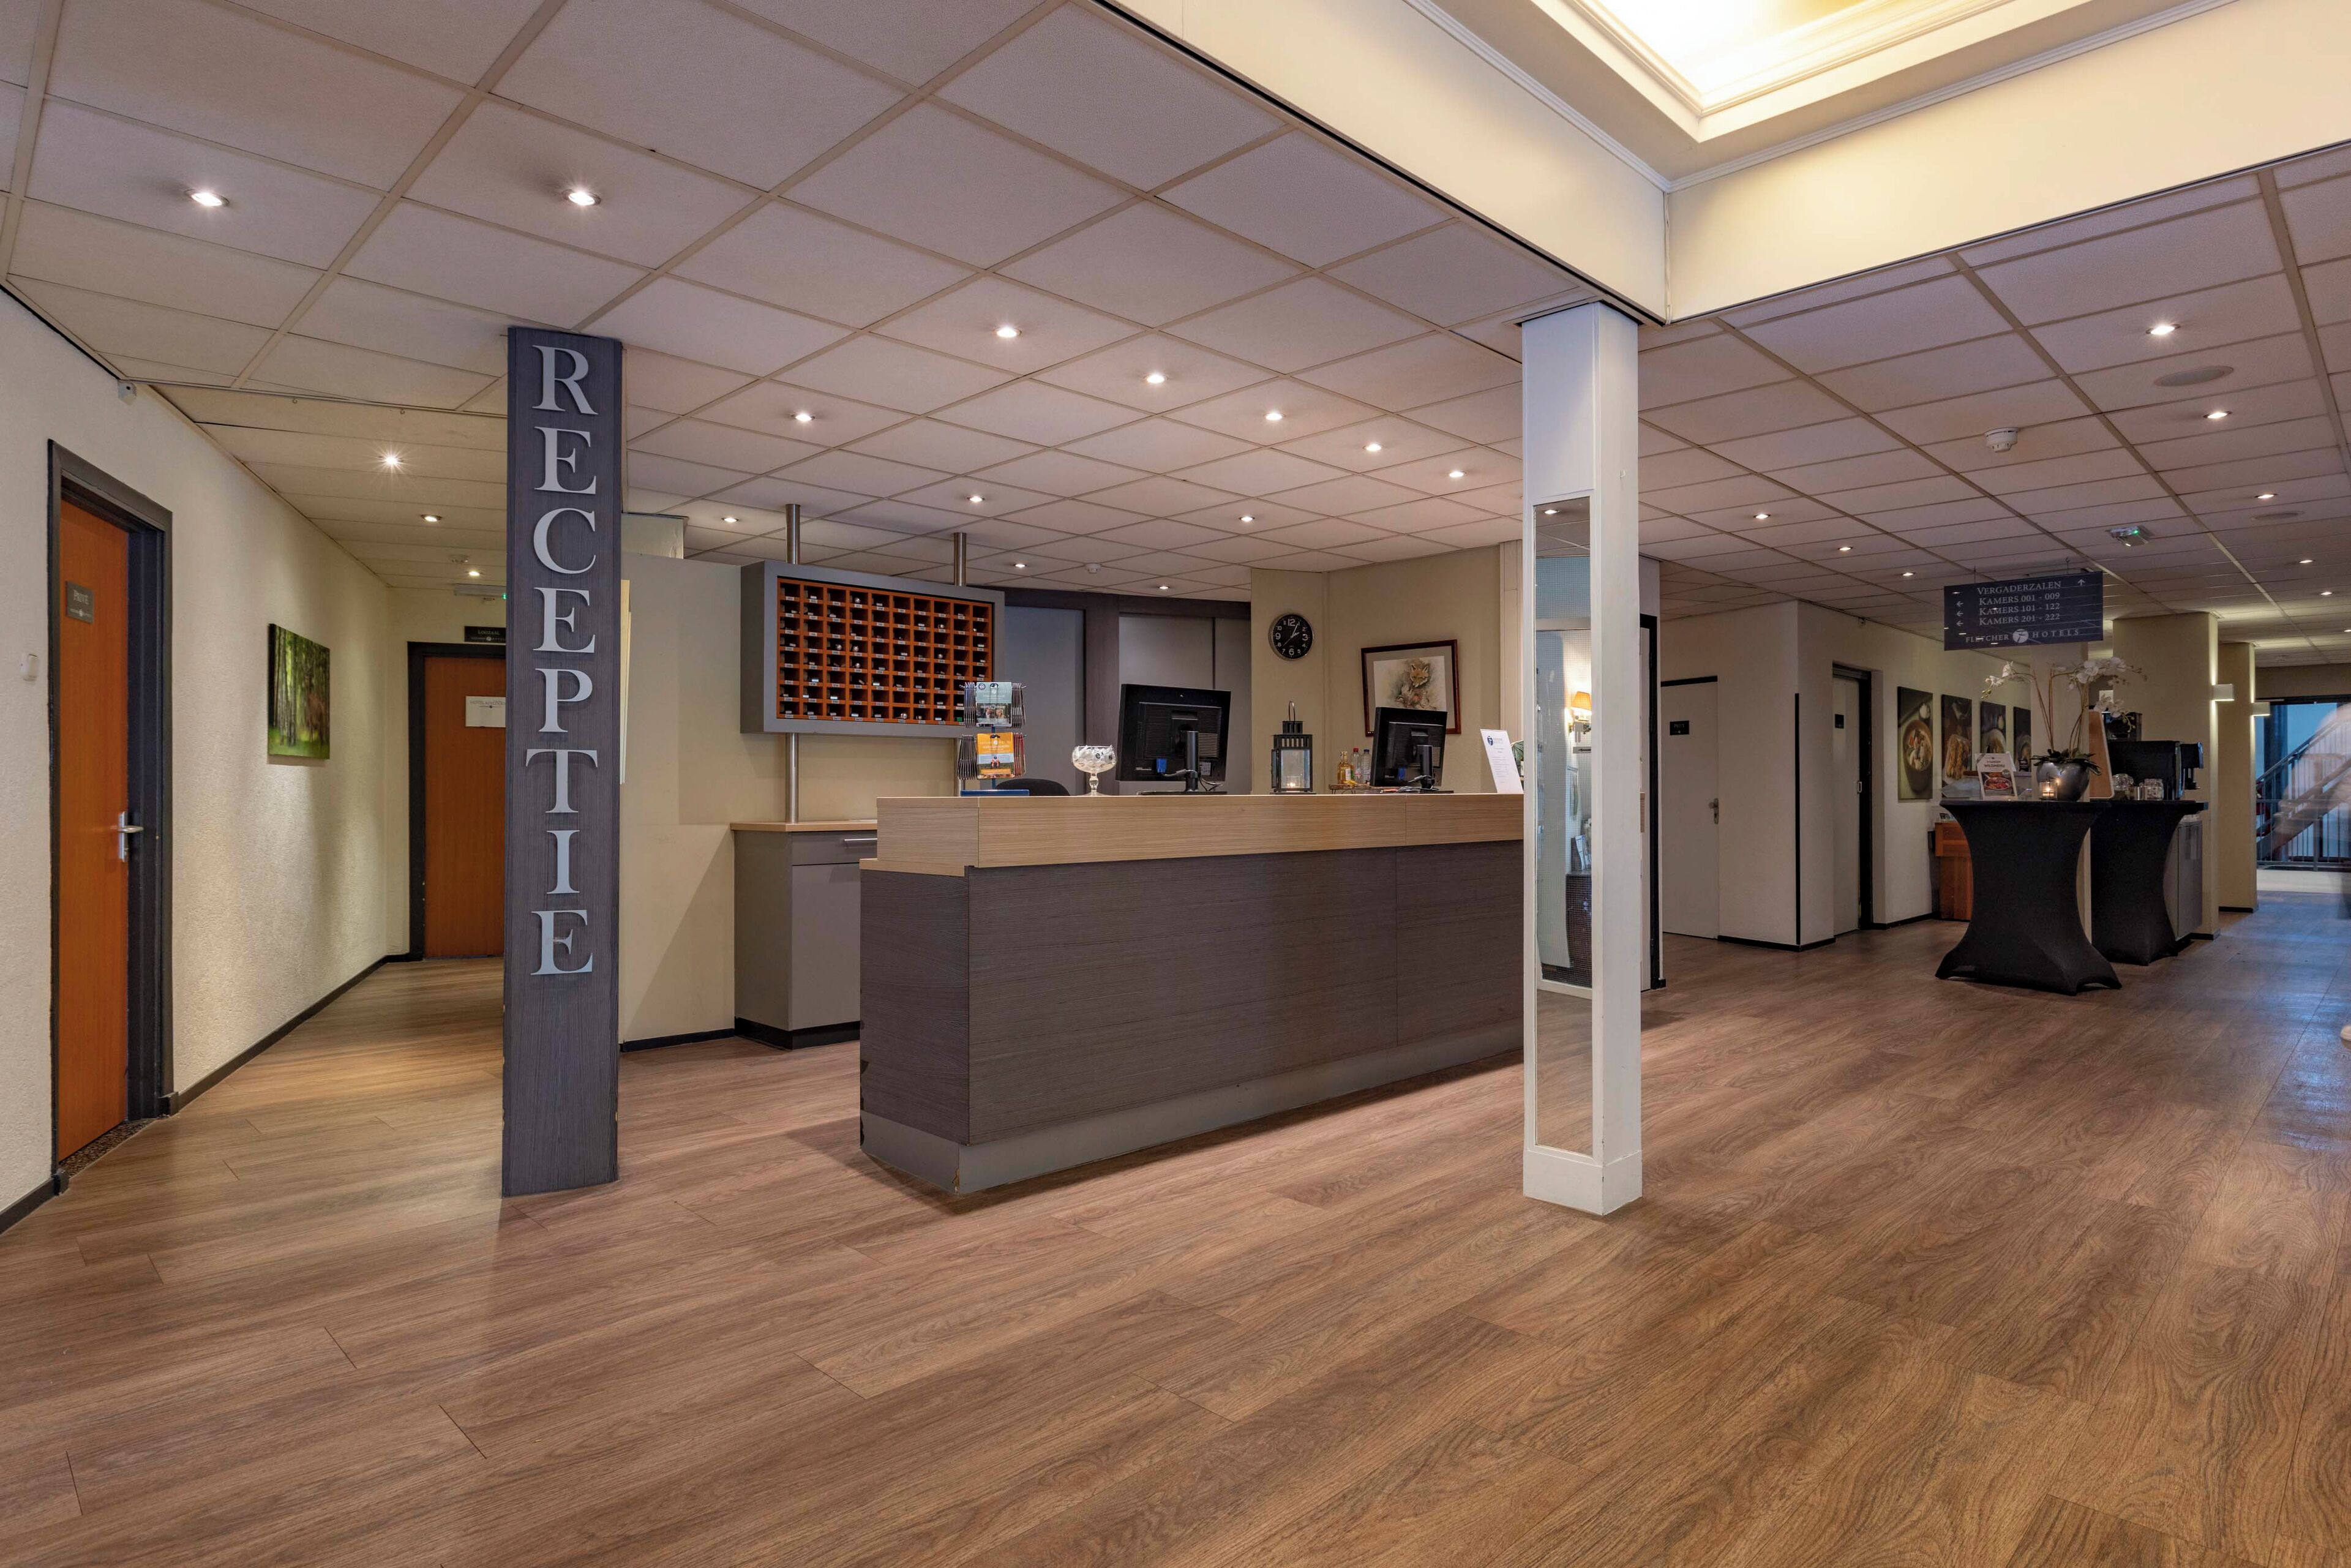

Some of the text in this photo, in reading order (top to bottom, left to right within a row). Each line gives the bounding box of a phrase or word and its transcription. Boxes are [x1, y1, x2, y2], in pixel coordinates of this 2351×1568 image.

[1977, 581, 2061, 595] VERGADERZALEN
[1979, 596, 2019, 606] KAMERS
[2045, 592, 2060, 601] 009
[1979, 606, 2019, 616] KAMERS
[1979, 616, 2019, 626] KAMERS
[1965, 629, 2079, 643] FLETCHER HOTELS
[525, 344, 598, 976] RECEPTIE
